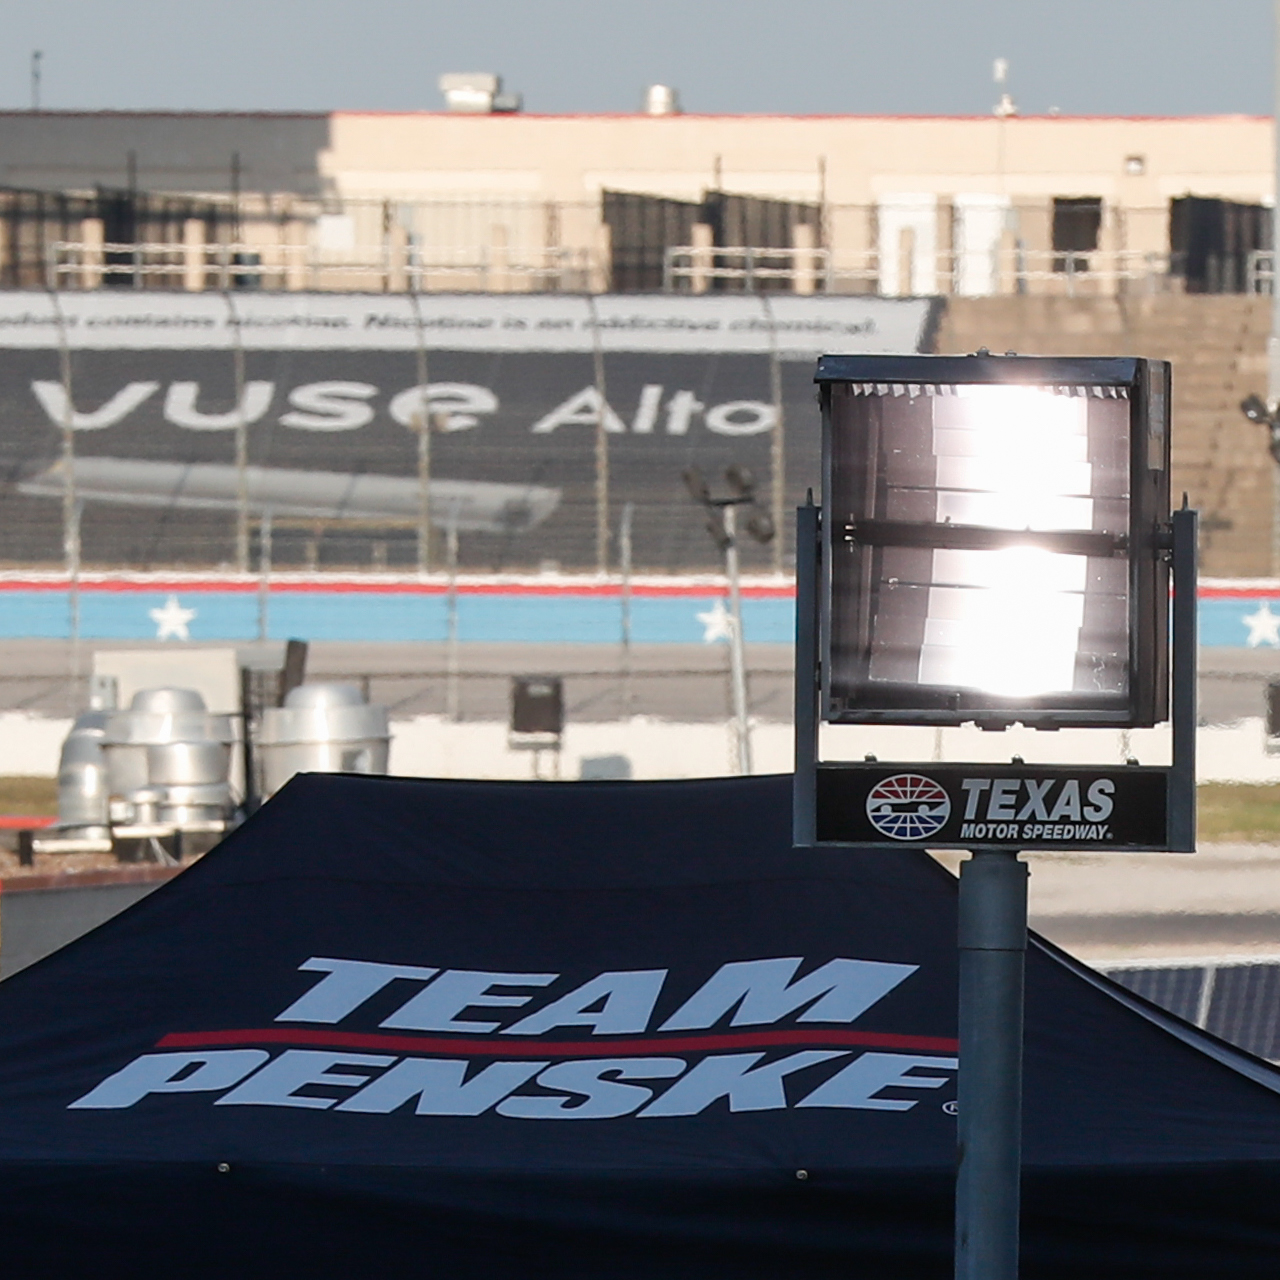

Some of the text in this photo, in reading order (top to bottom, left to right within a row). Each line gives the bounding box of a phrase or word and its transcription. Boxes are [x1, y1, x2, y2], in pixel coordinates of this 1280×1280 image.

[530, 383, 779, 437] Alto
[960, 778, 1116, 823] TEXAS
[960, 823, 1108, 841] MOTOR SPEEDWAY
[273, 956, 920, 1035] TEAM
[66, 1047, 959, 1120] PENSKE
